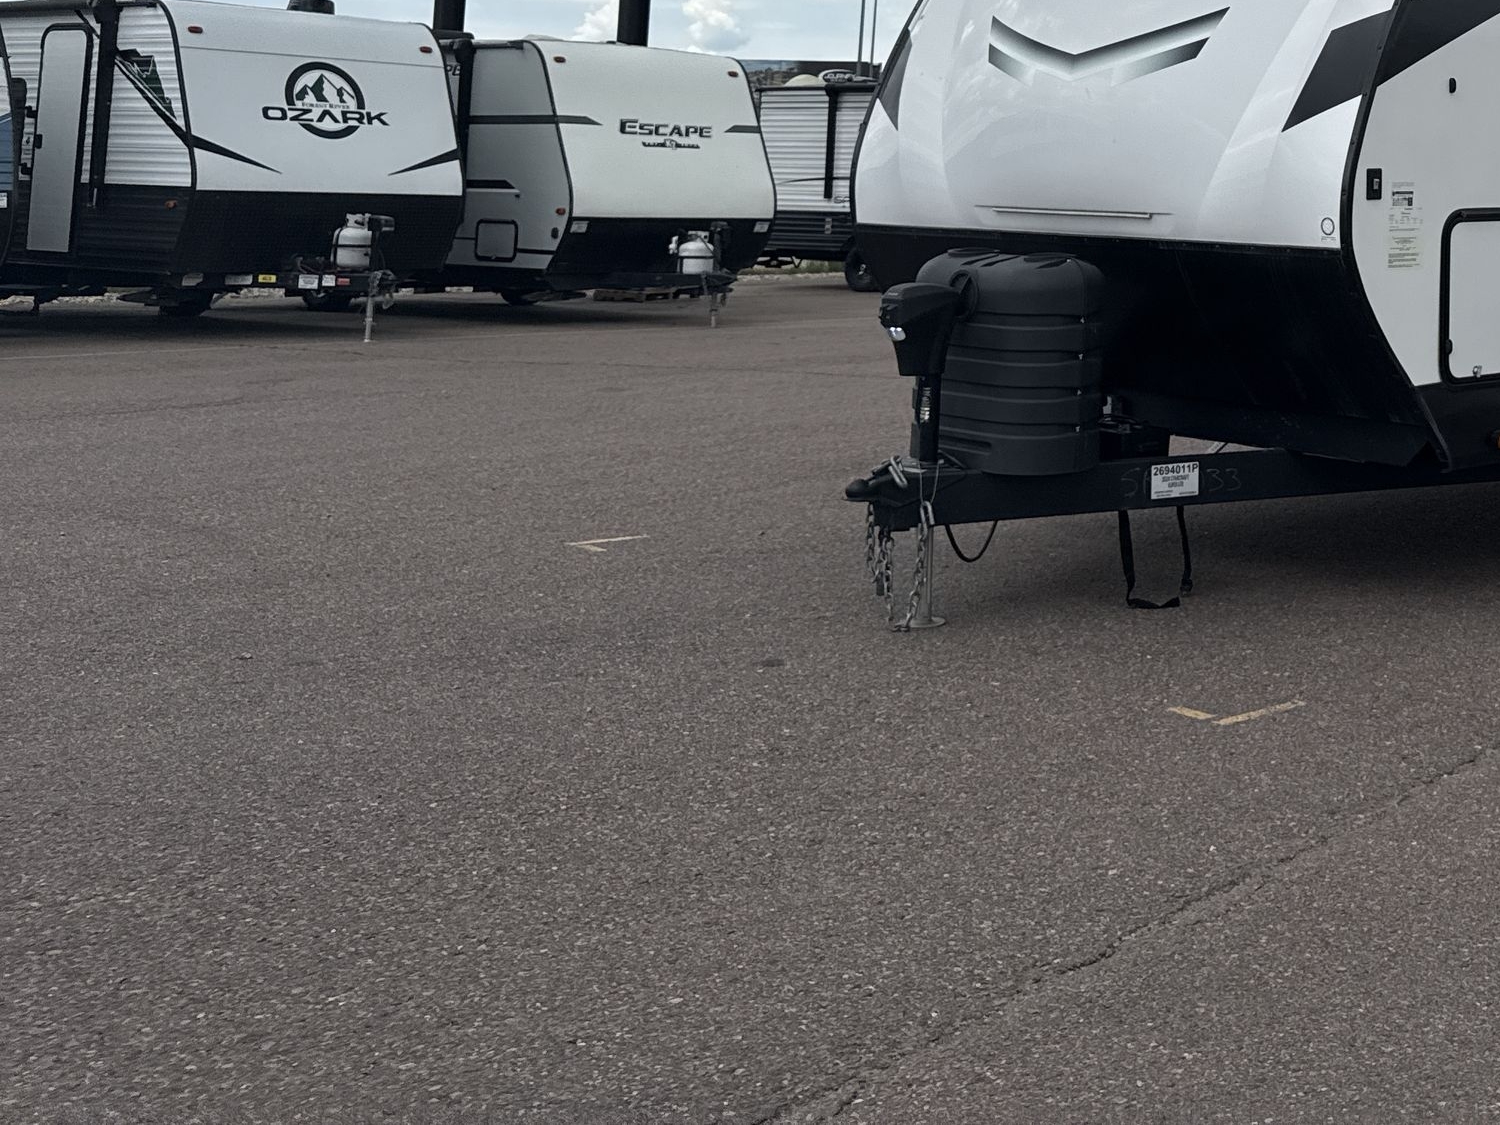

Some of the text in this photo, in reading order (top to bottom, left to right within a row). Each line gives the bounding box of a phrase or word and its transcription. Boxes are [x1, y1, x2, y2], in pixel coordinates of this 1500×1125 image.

[261, 106, 391, 127] OZARK
[619, 118, 713, 139] ESCAPE
[1153, 463, 1199, 476] 2694011P
